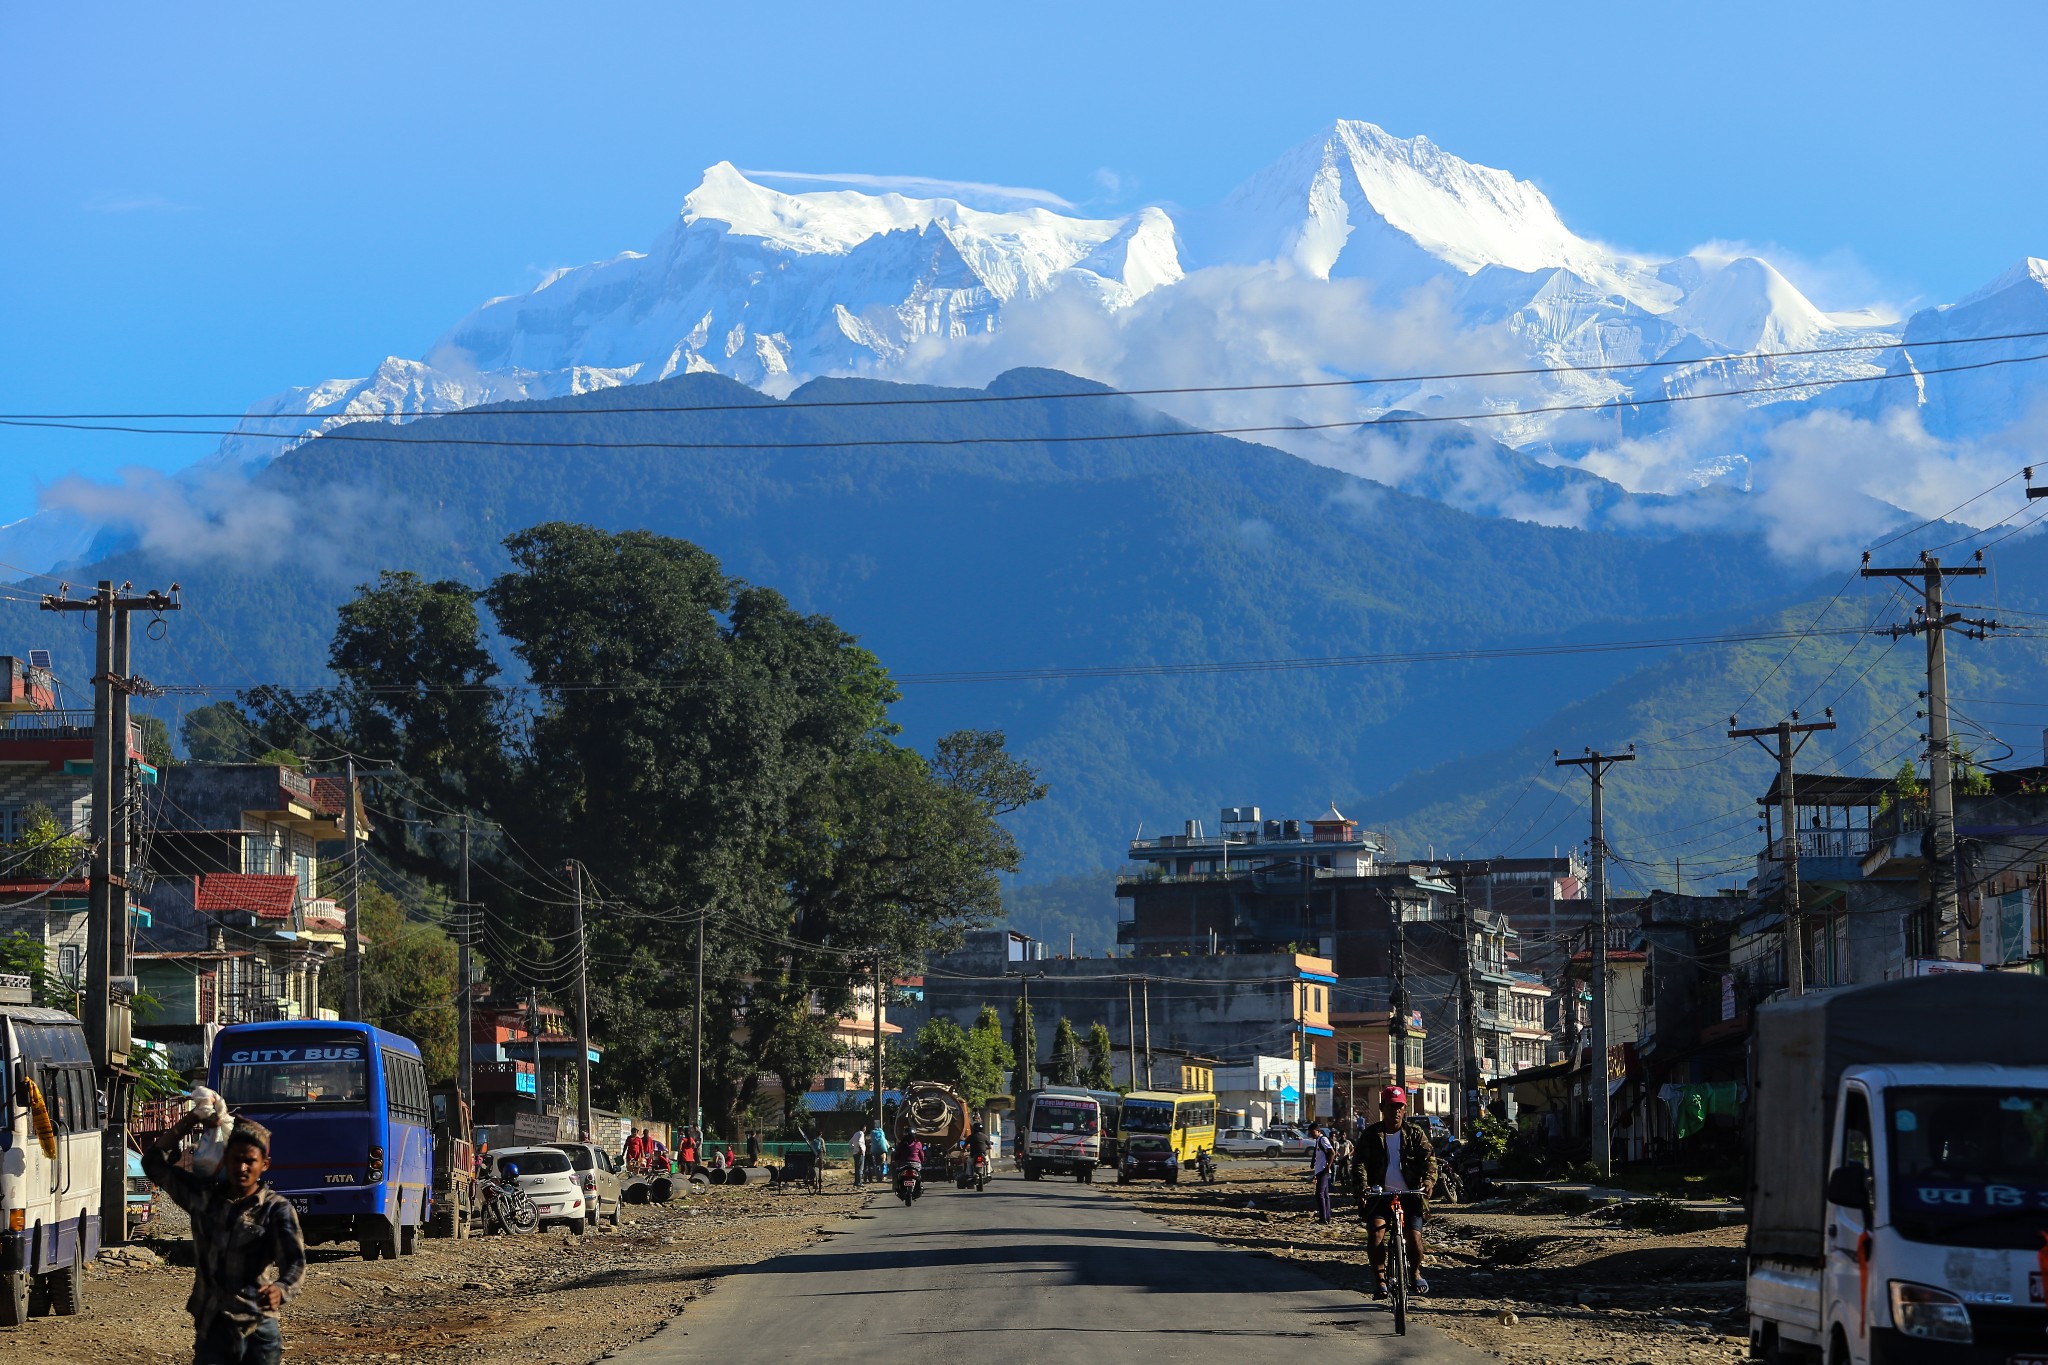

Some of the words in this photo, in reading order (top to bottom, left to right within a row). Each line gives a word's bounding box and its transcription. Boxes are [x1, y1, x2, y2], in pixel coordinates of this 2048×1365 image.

[231, 1049, 297, 1062] CITY
[304, 1047, 360, 1060] BUS
[324, 1174, 356, 1183] TATA
